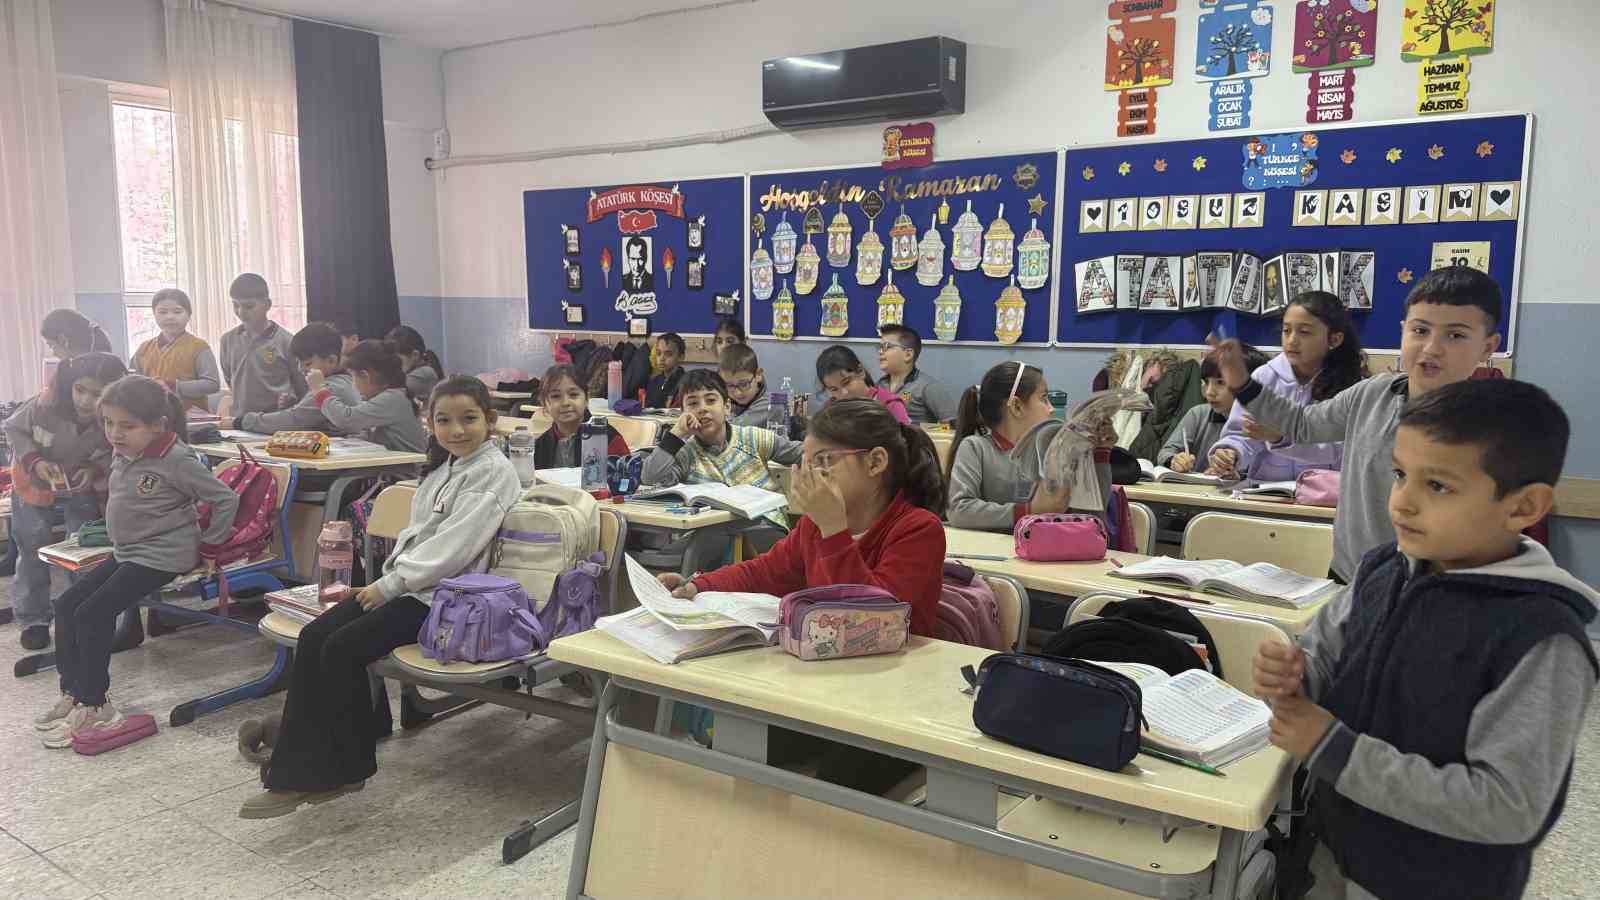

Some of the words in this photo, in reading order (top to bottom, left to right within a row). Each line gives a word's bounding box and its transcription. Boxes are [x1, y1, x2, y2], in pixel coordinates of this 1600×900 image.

[1423, 62, 1464, 76] HAZİRAN
[1319, 75, 1344, 87] MART
[1423, 81, 1461, 93] TEMMUZ
[1214, 83, 1246, 96] ARALIK
[1317, 92, 1346, 105] NİSAN
[1217, 101, 1242, 112] OCAK
[1419, 98, 1463, 112] AĞUSTOS
[1316, 109, 1344, 121] MAYIS
[1216, 117, 1241, 129] ŞUBAT
[597, 191, 635, 209] ATATÜRK
